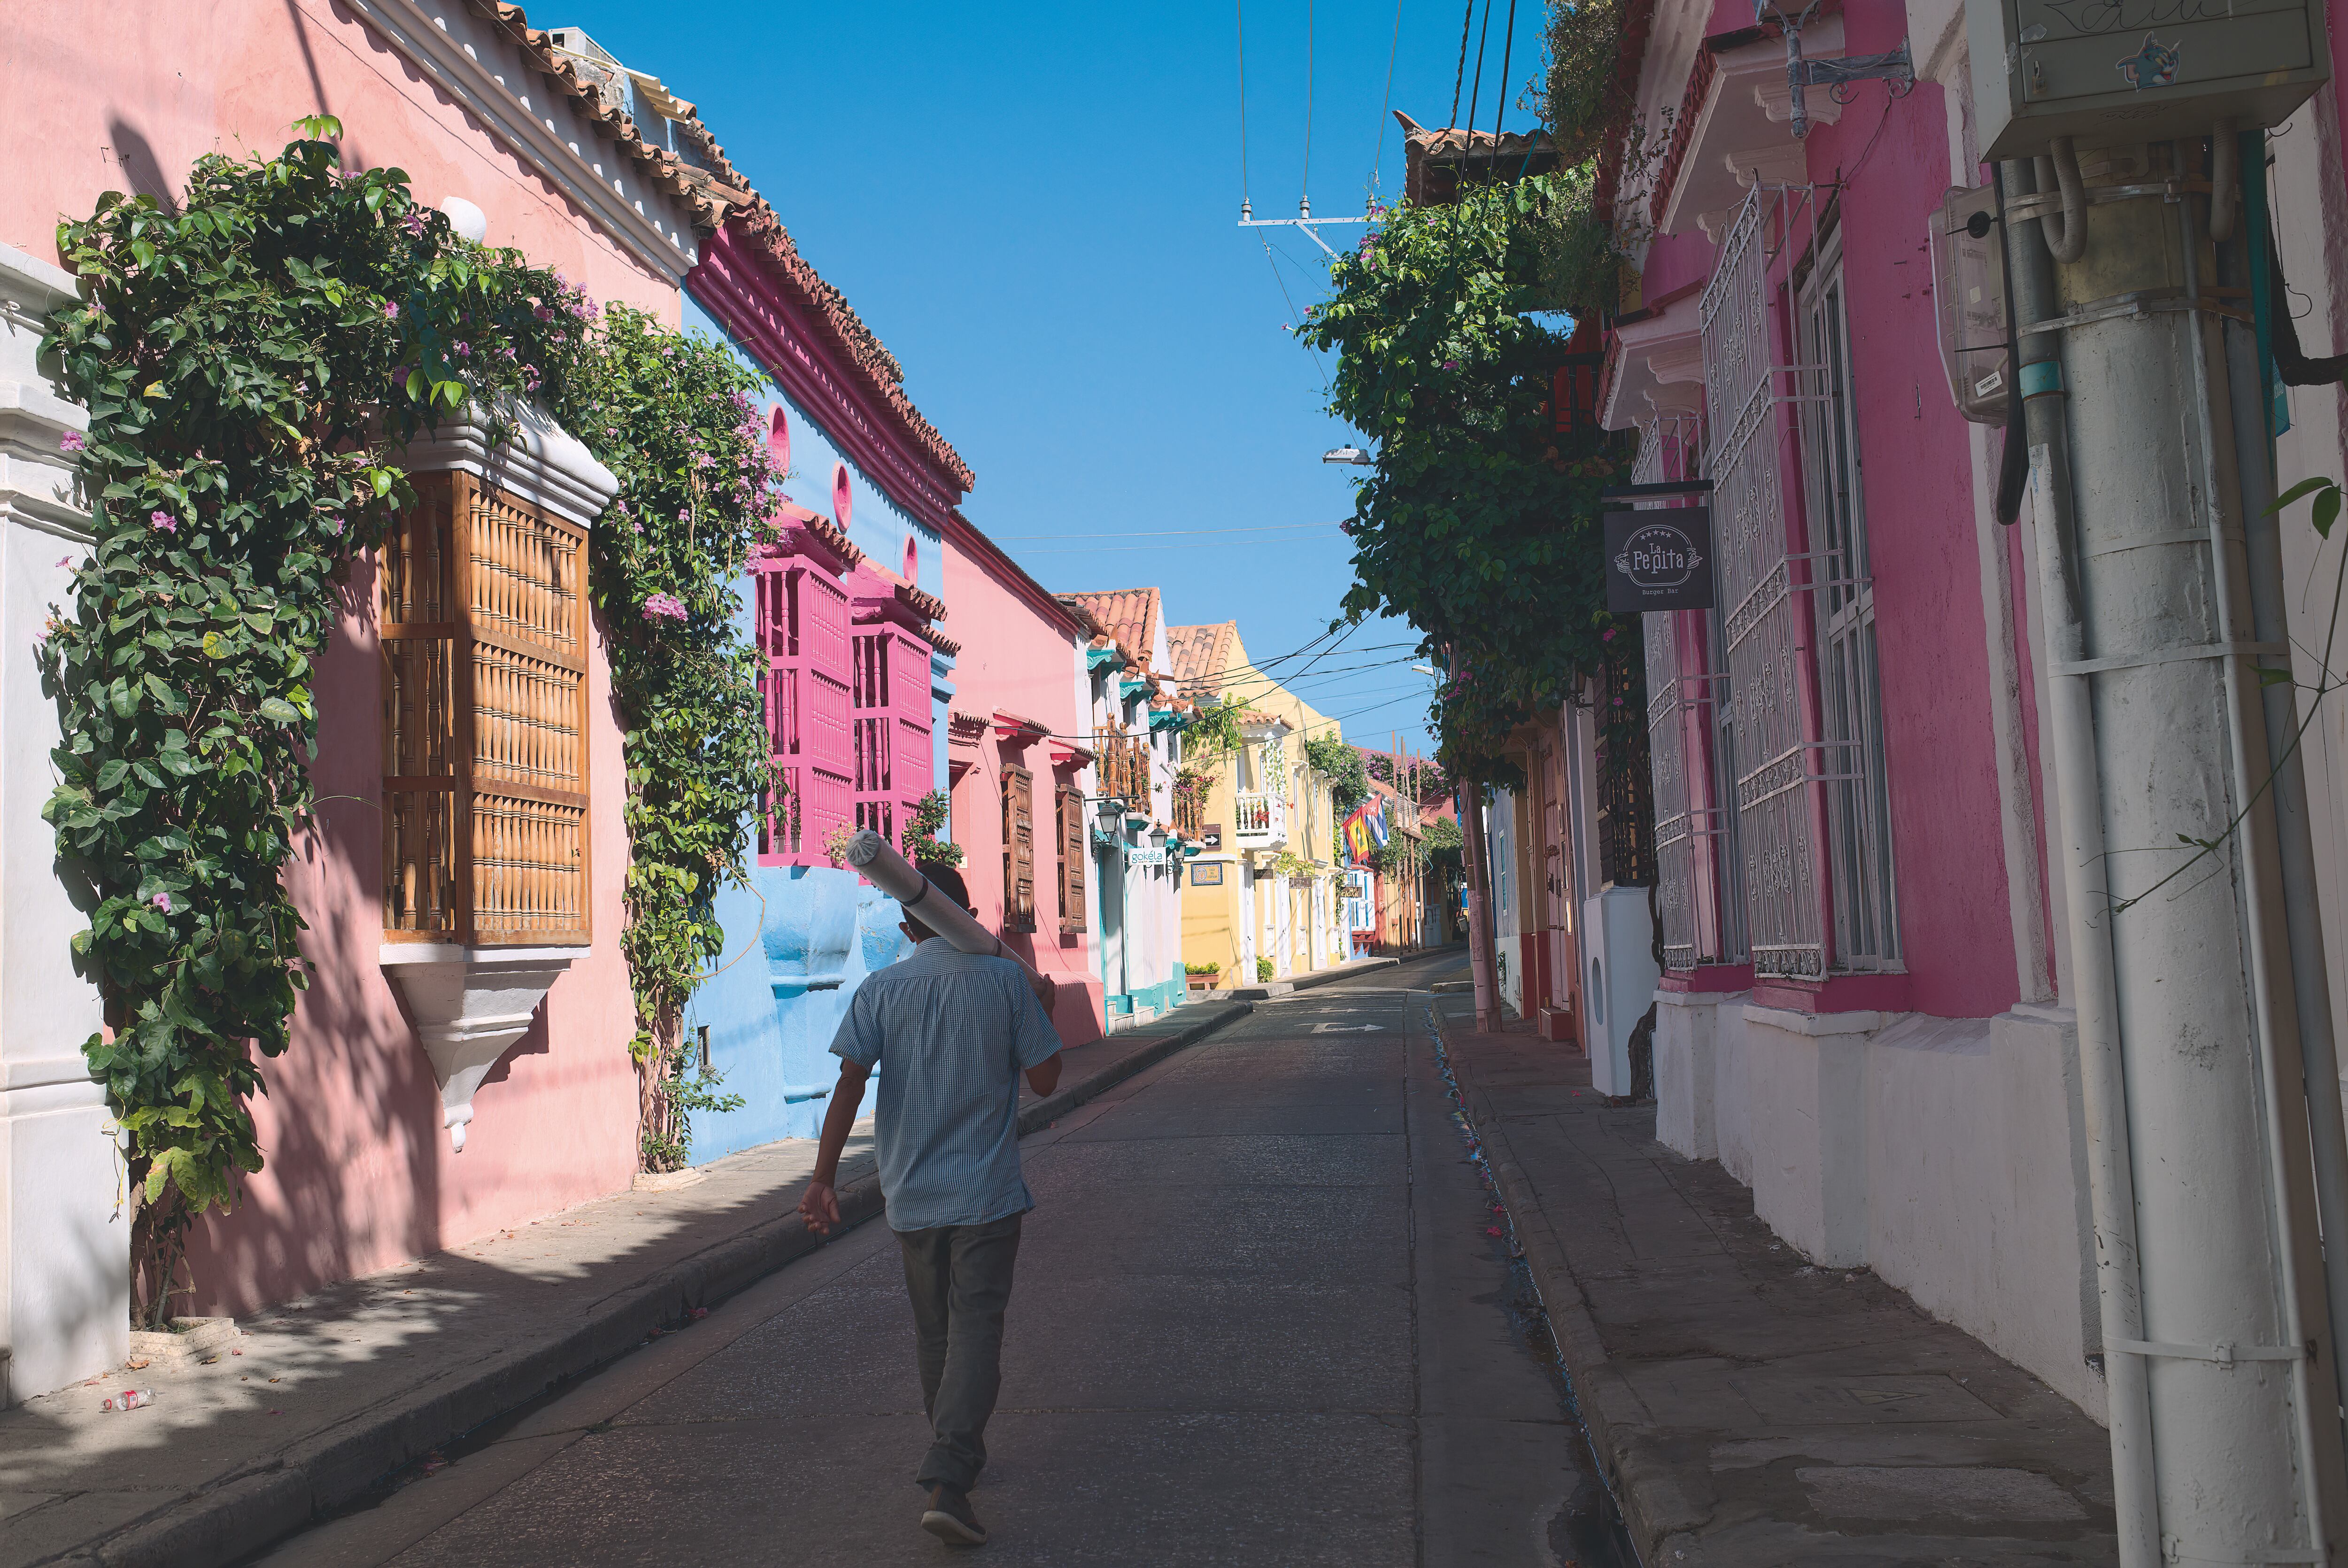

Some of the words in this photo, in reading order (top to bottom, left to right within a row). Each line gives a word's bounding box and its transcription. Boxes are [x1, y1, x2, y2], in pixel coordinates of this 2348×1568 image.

[1649, 543, 1661, 554] La
[1633, 549, 1684, 574] Pepita
[1132, 850, 1162, 864] gokéla
